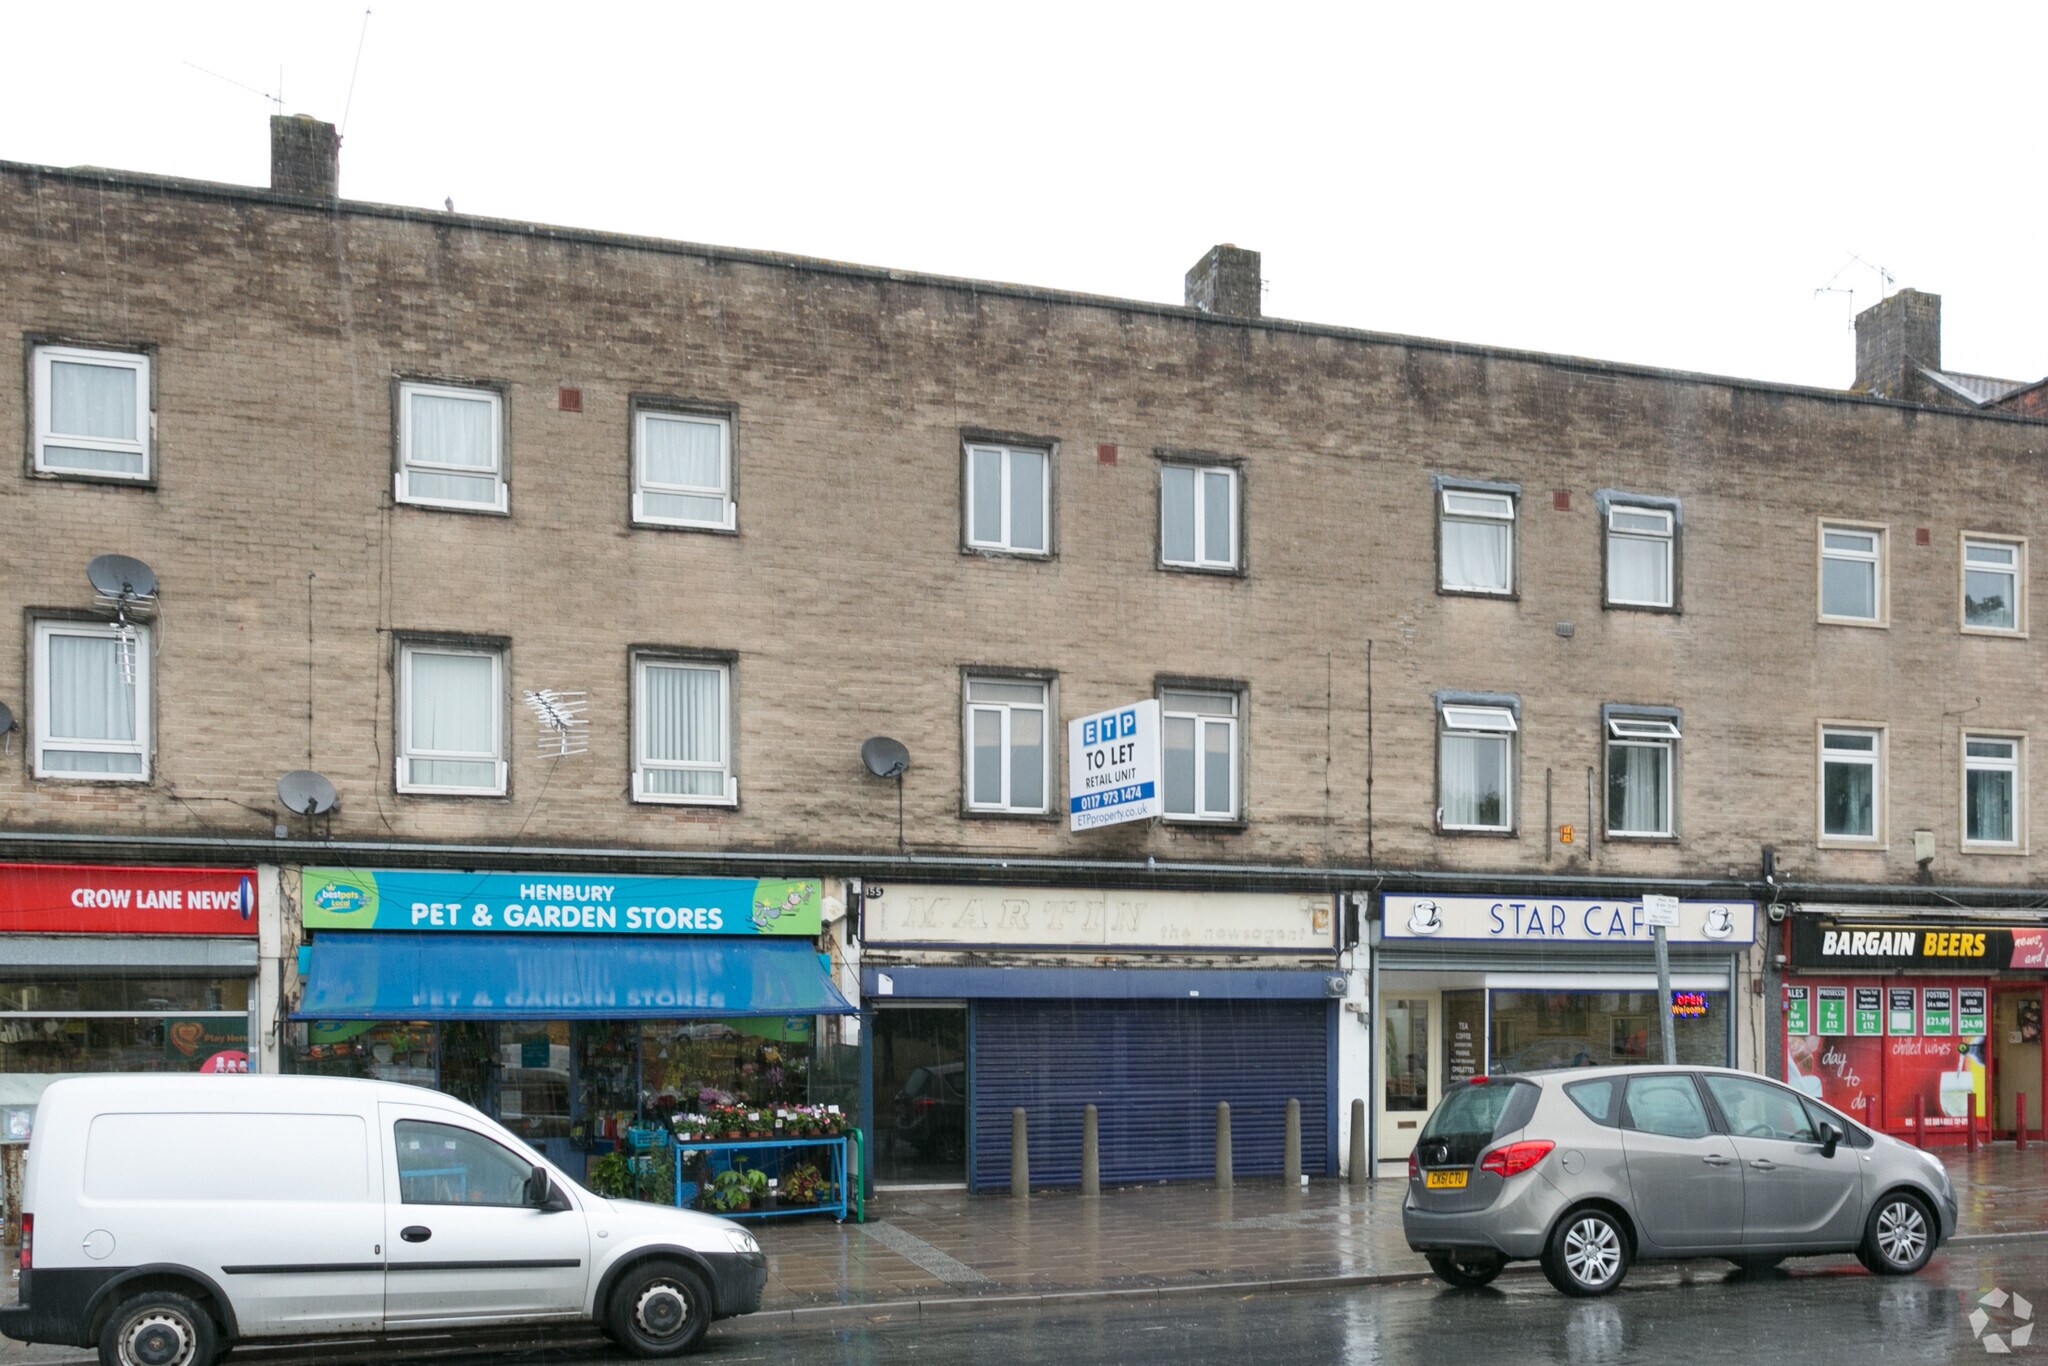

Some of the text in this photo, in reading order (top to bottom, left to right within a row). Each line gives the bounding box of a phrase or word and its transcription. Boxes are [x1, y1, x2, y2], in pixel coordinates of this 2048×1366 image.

[1085, 713, 1134, 743] ETP
[1086, 742, 1135, 771] TO LET
[1085, 767, 1137, 789] RETAIL UNIT
[1081, 785, 1142, 810] 0117 973 1474
[1077, 803, 1148, 827] ETPproperty.co.uk
[71, 888, 240, 911] CROW LANE NEWS
[322, 889, 358, 900] bestpets
[519, 883, 615, 902] HENBURY
[866, 887, 882, 897] 155
[411, 903, 723, 930] PET & GARDEN STORES
[900, 896, 1147, 932] MARTIN
[1490, 903, 1566, 936] STAR
[1822, 931, 1986, 957] BARGAIN BEERS
[2024, 947, 2045, 964] and
[1677, 995, 1703, 1006] OPEN
[1820, 989, 1845, 997] PROSECCO
[1926, 991, 1950, 999] FOSTERS
[1671, 1005, 1706, 1015] Welcome
[1829, 1003, 1835, 1011] 2
[1458, 1021, 1469, 1030] TEA
[1826, 1020, 1838, 1029] £12
[1926, 1016, 1950, 1026] £21.99
[1960, 1020, 1983, 1028] £24.99
[1892, 1037, 1951, 1056] chilled wines
[1822, 1046, 1847, 1077] day
[1844, 1068, 1861, 1088] to
